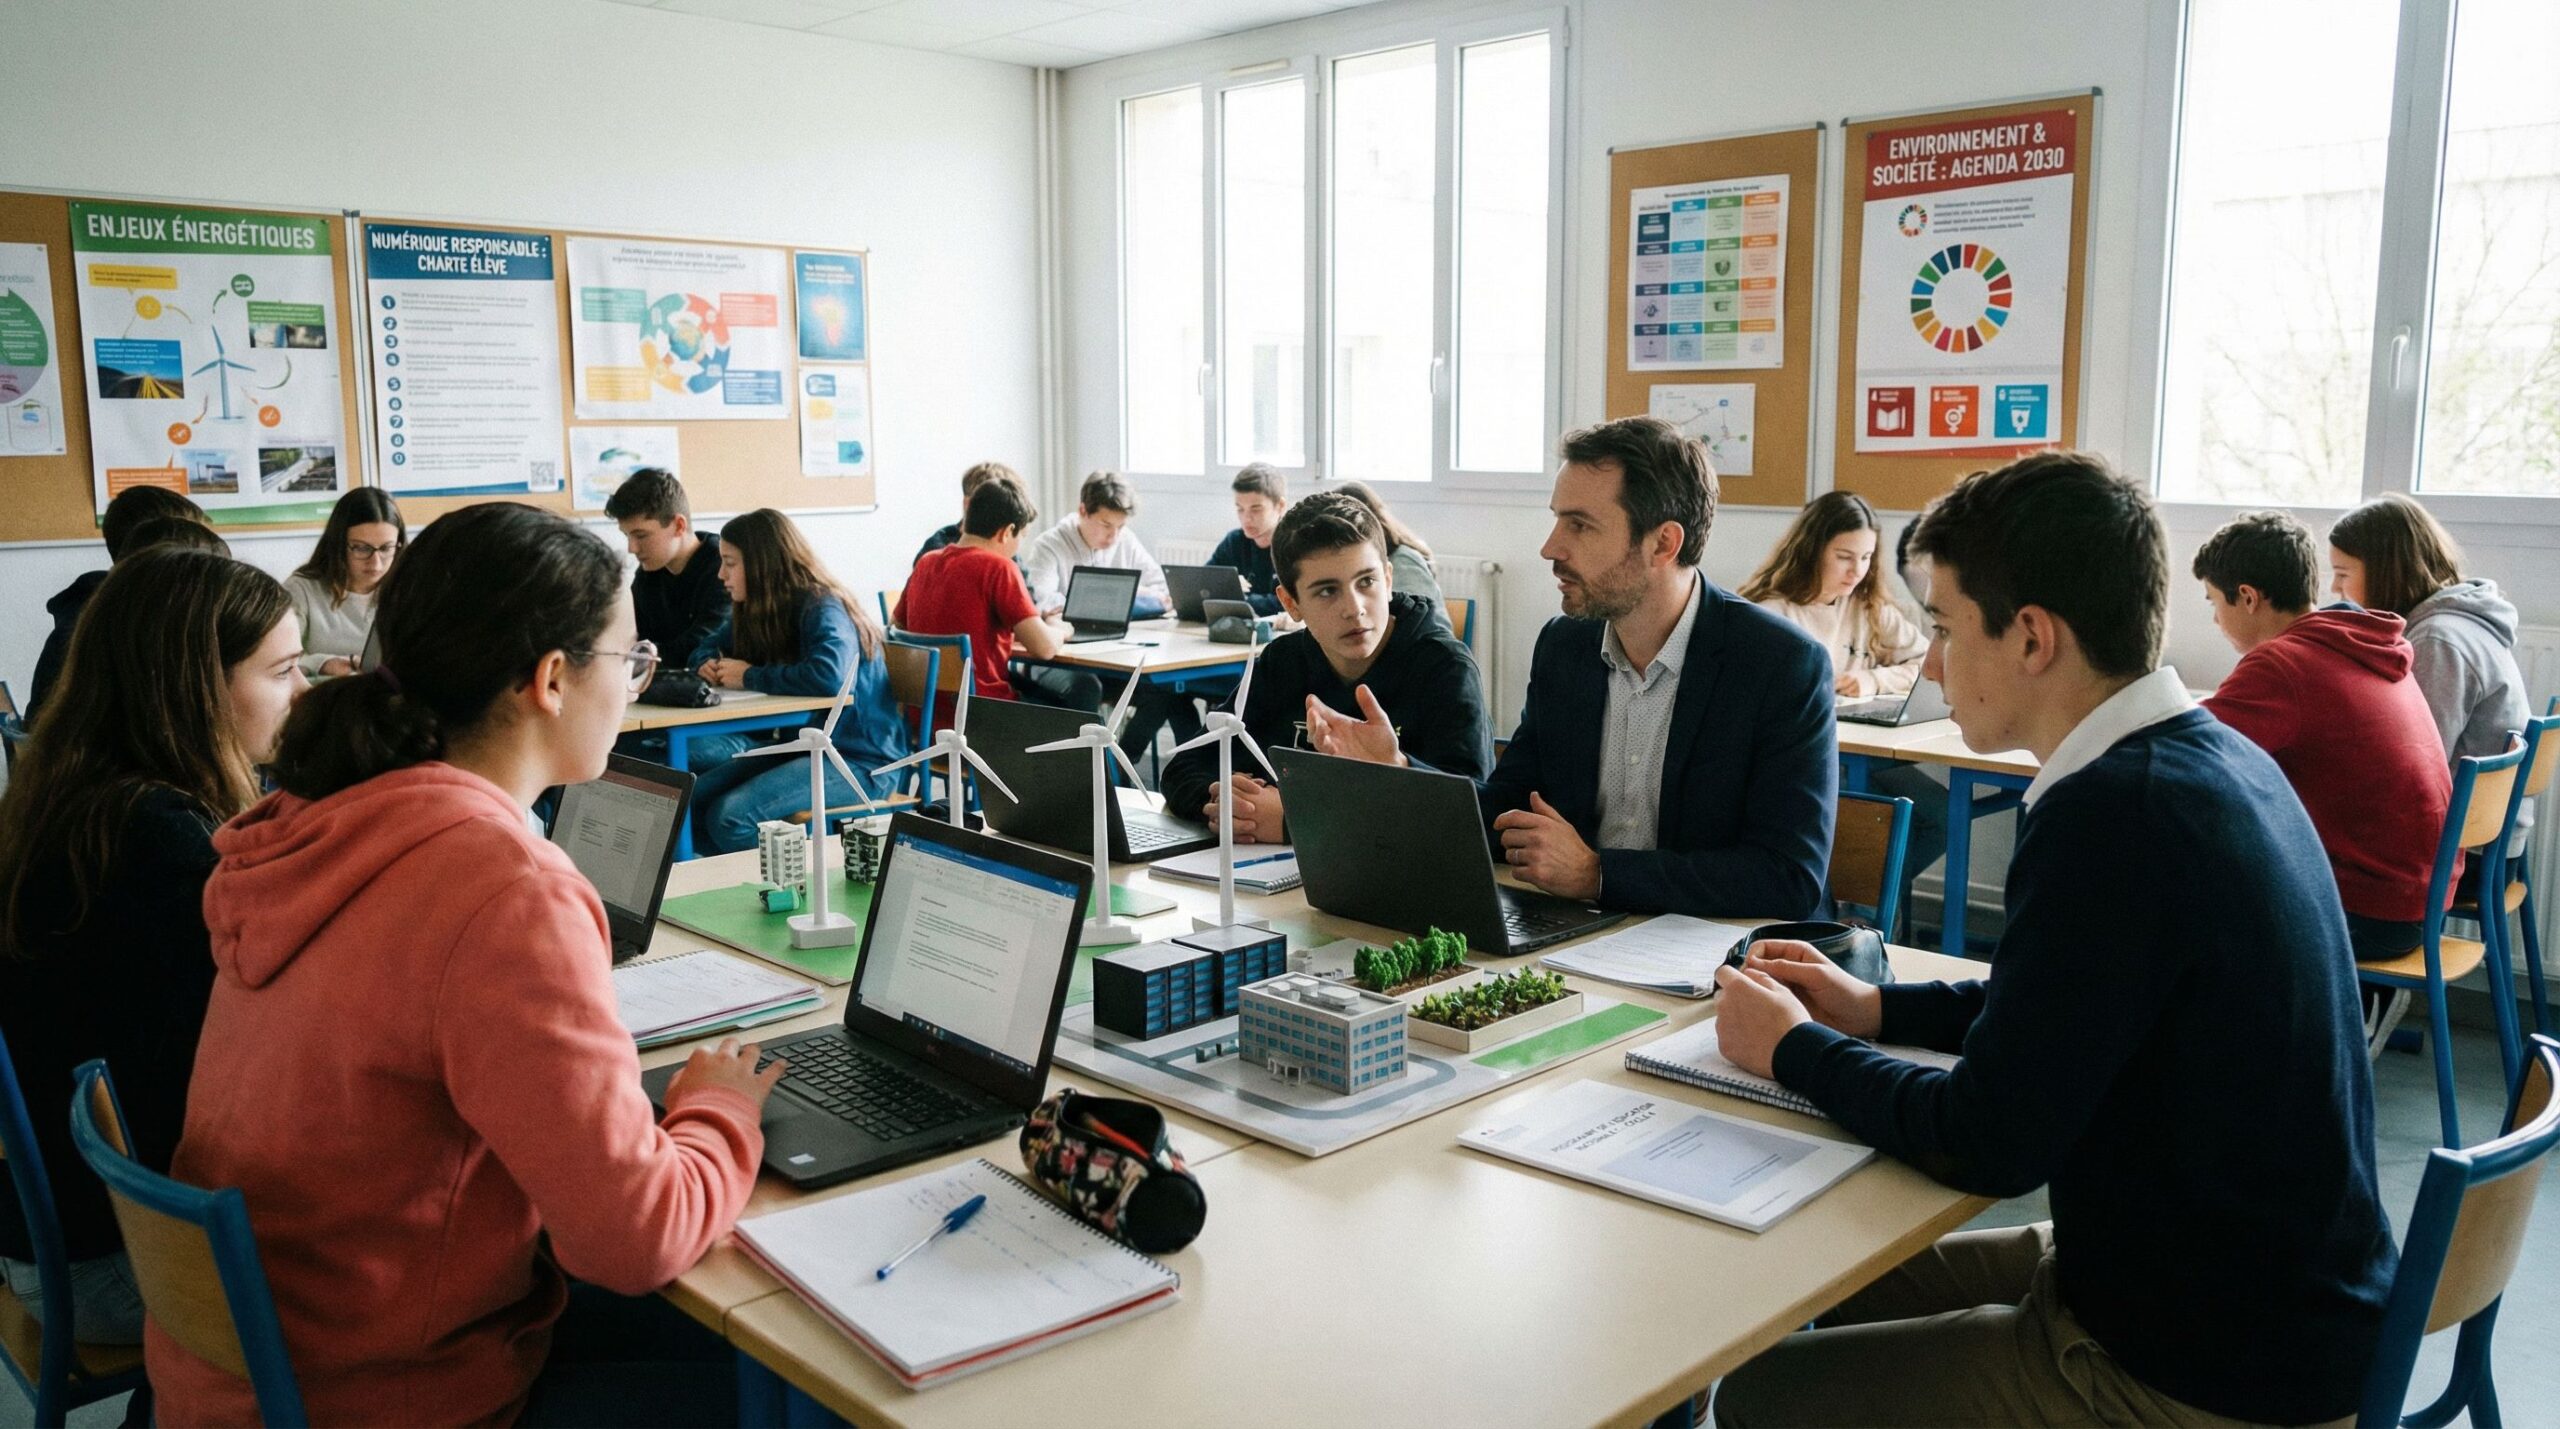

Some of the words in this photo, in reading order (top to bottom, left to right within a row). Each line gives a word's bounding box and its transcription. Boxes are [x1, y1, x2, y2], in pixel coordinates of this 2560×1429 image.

[1889, 124, 2030, 159] ENVIRONNEMENT
[2033, 122, 2046, 143] &
[1872, 157, 1937, 187] SOCIÉTÉ
[1950, 152, 2019, 179] AGENDA
[2023, 147, 2065, 172] 2030
[87, 214, 167, 241] ENJEUX
[172, 215, 316, 249] ÉNERGÉTIQUES
[371, 231, 449, 254] NUMÉRIQUE
[417, 255, 469, 274] CHARTE
[470, 253, 508, 276] ÉLÈVE
